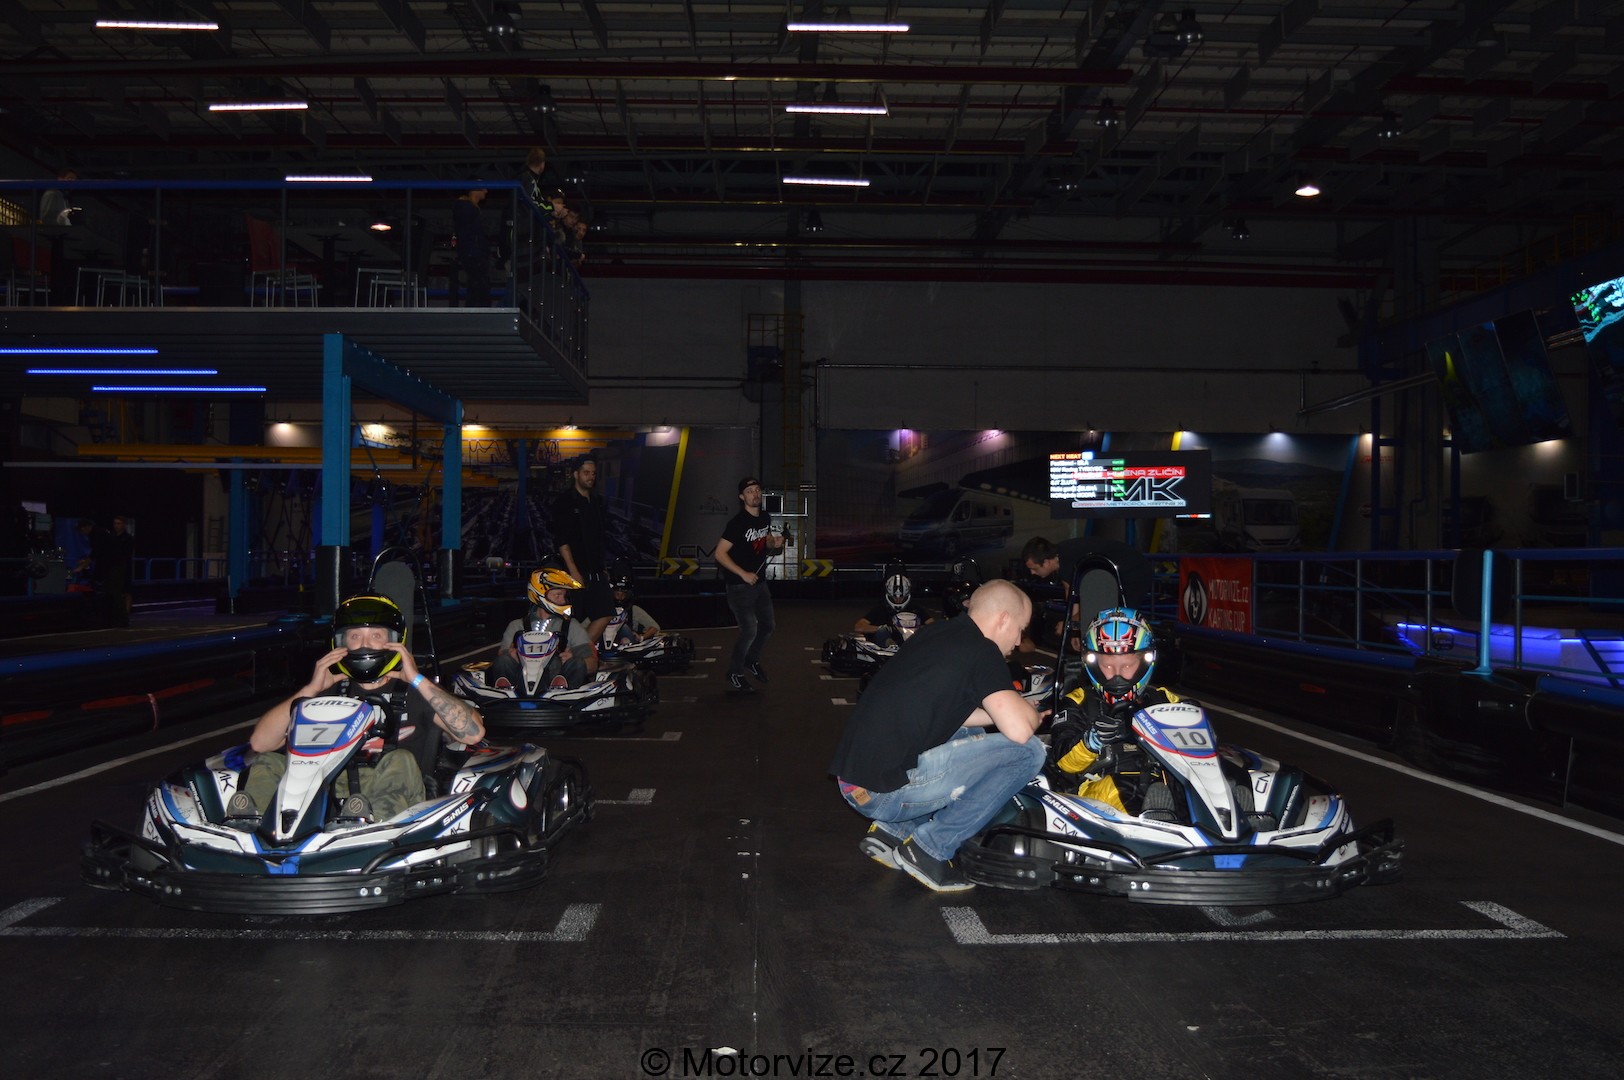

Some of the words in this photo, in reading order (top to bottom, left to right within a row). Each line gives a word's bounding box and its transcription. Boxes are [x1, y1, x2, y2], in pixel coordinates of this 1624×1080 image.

[528, 645, 543, 653] 11
[311, 727, 329, 742] 7
[1173, 731, 1207, 746] 10
